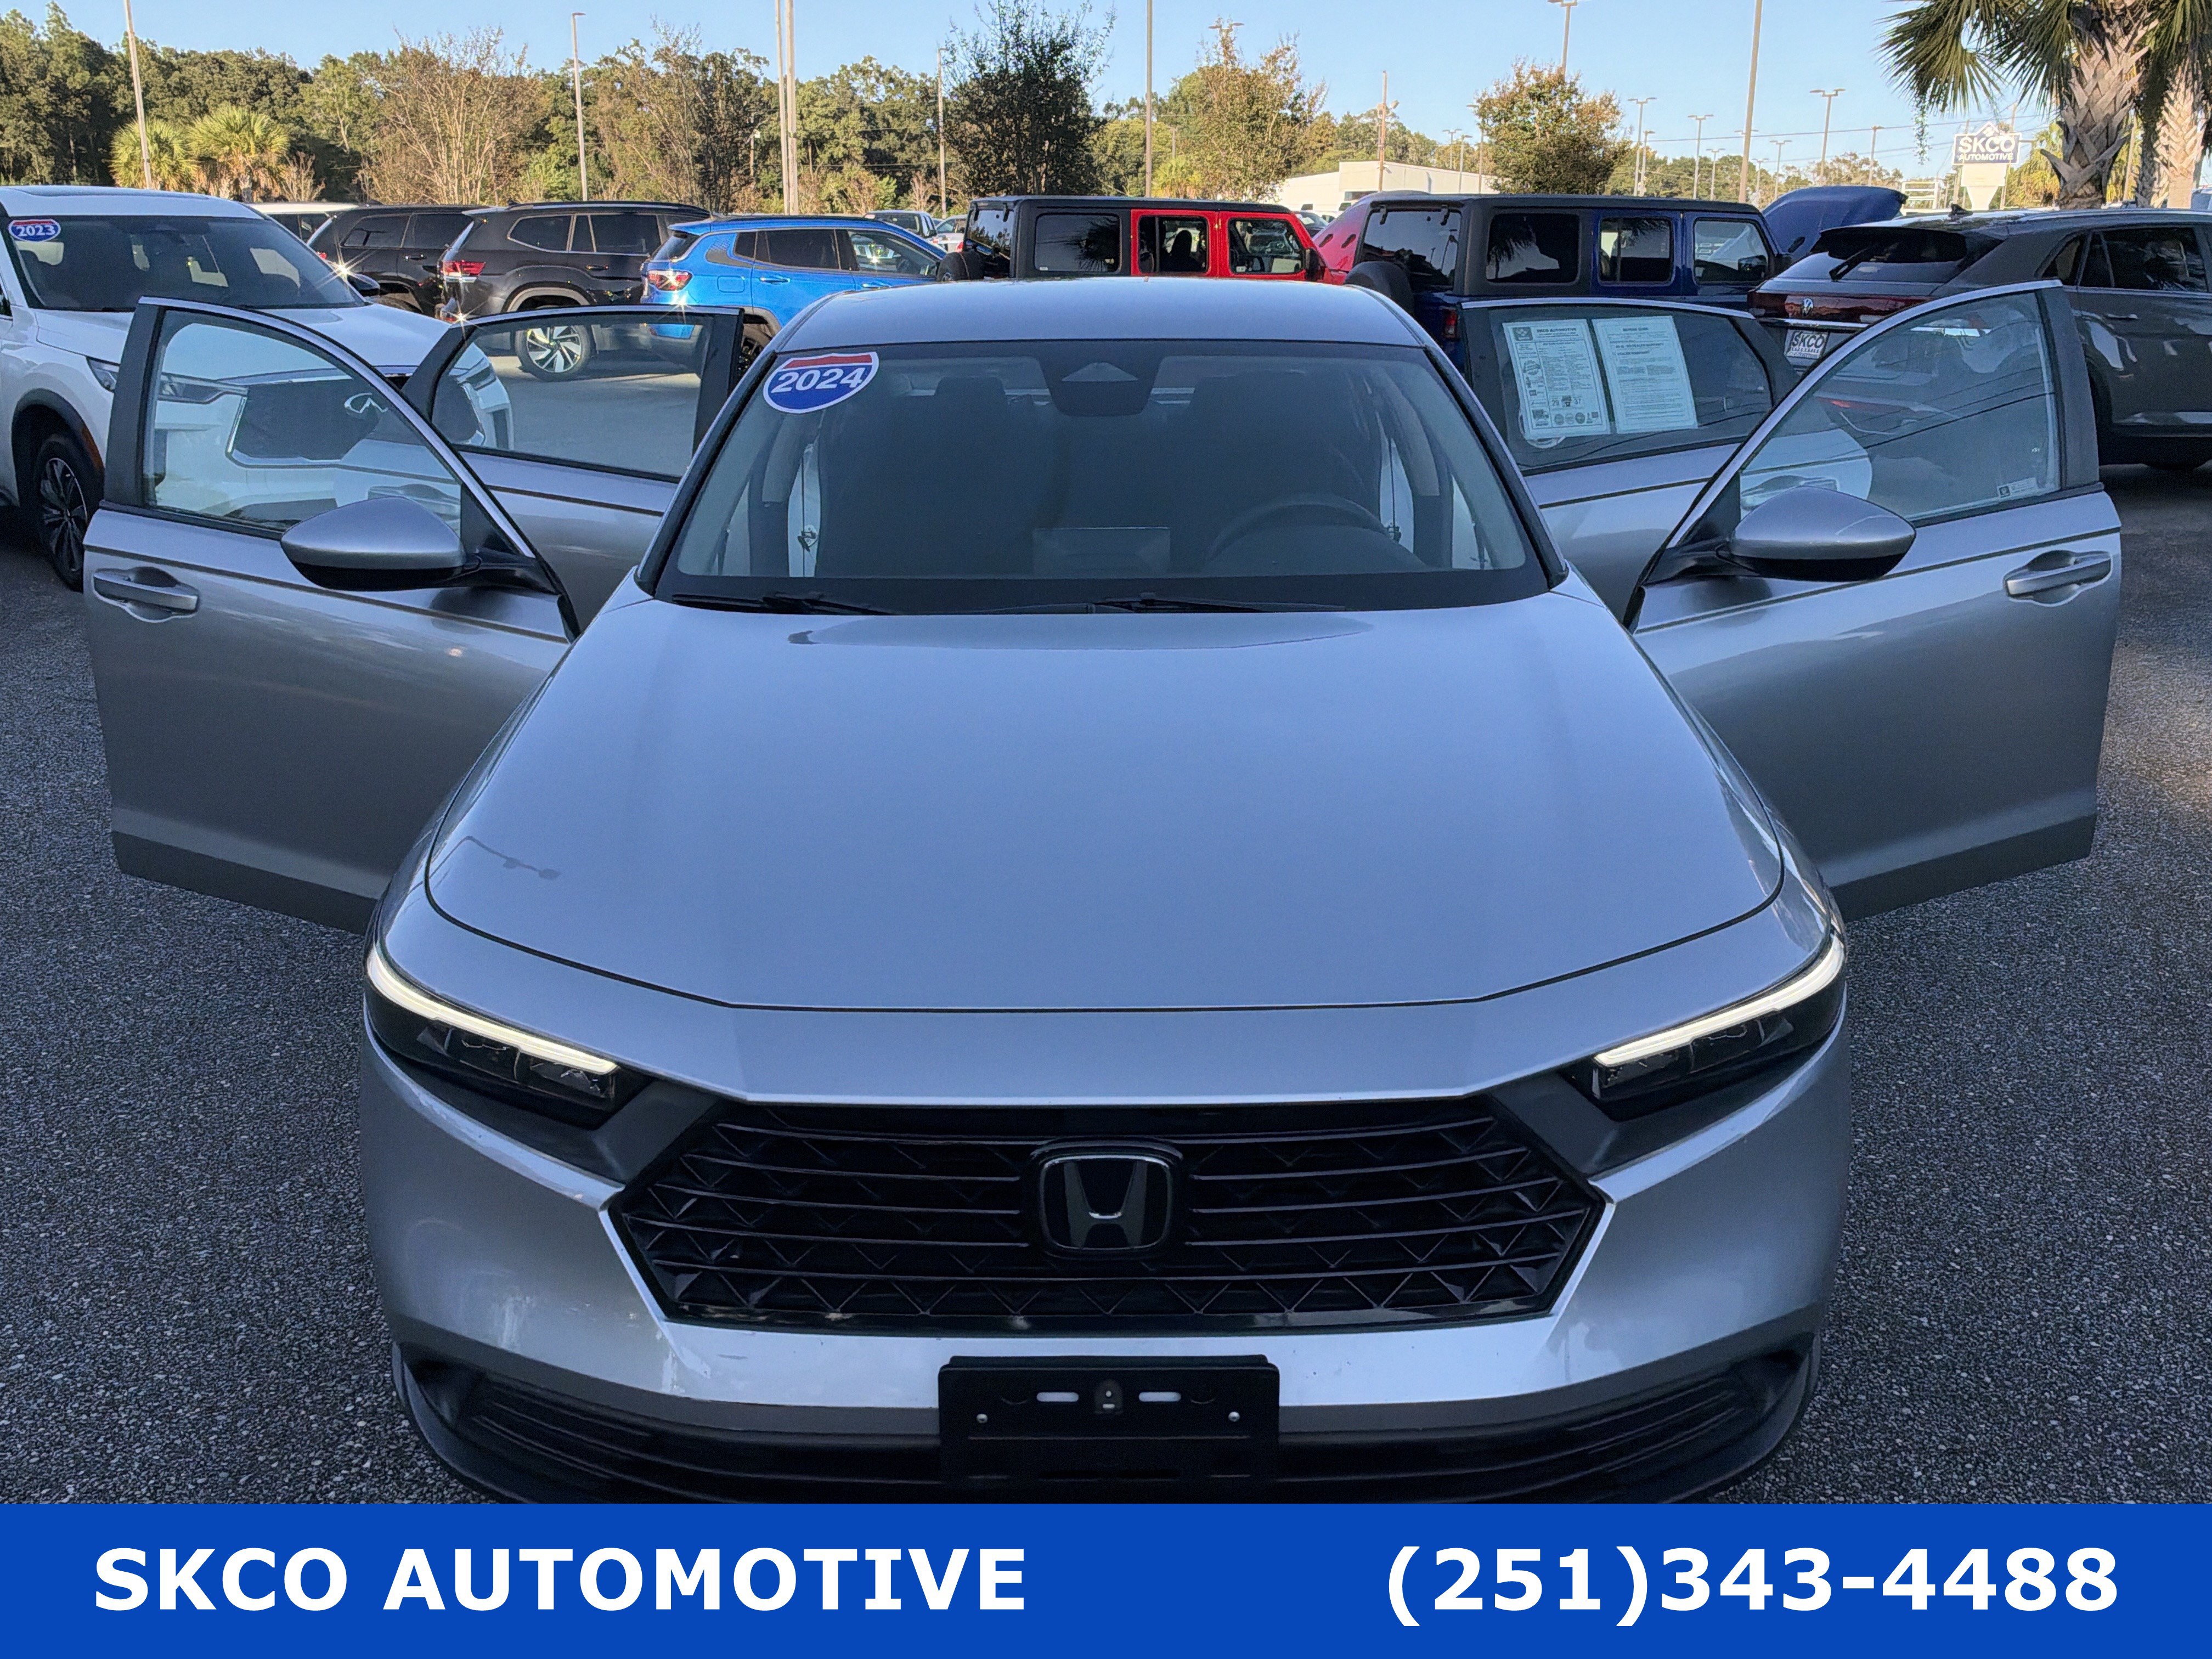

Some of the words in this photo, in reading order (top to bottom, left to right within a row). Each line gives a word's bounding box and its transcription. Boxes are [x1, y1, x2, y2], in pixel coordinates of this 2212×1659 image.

[1959, 136, 2016, 153] SKCO
[16, 225, 55, 236] 2023
[1792, 332, 1825, 348] SKCO
[771, 367, 866, 393] 2024
